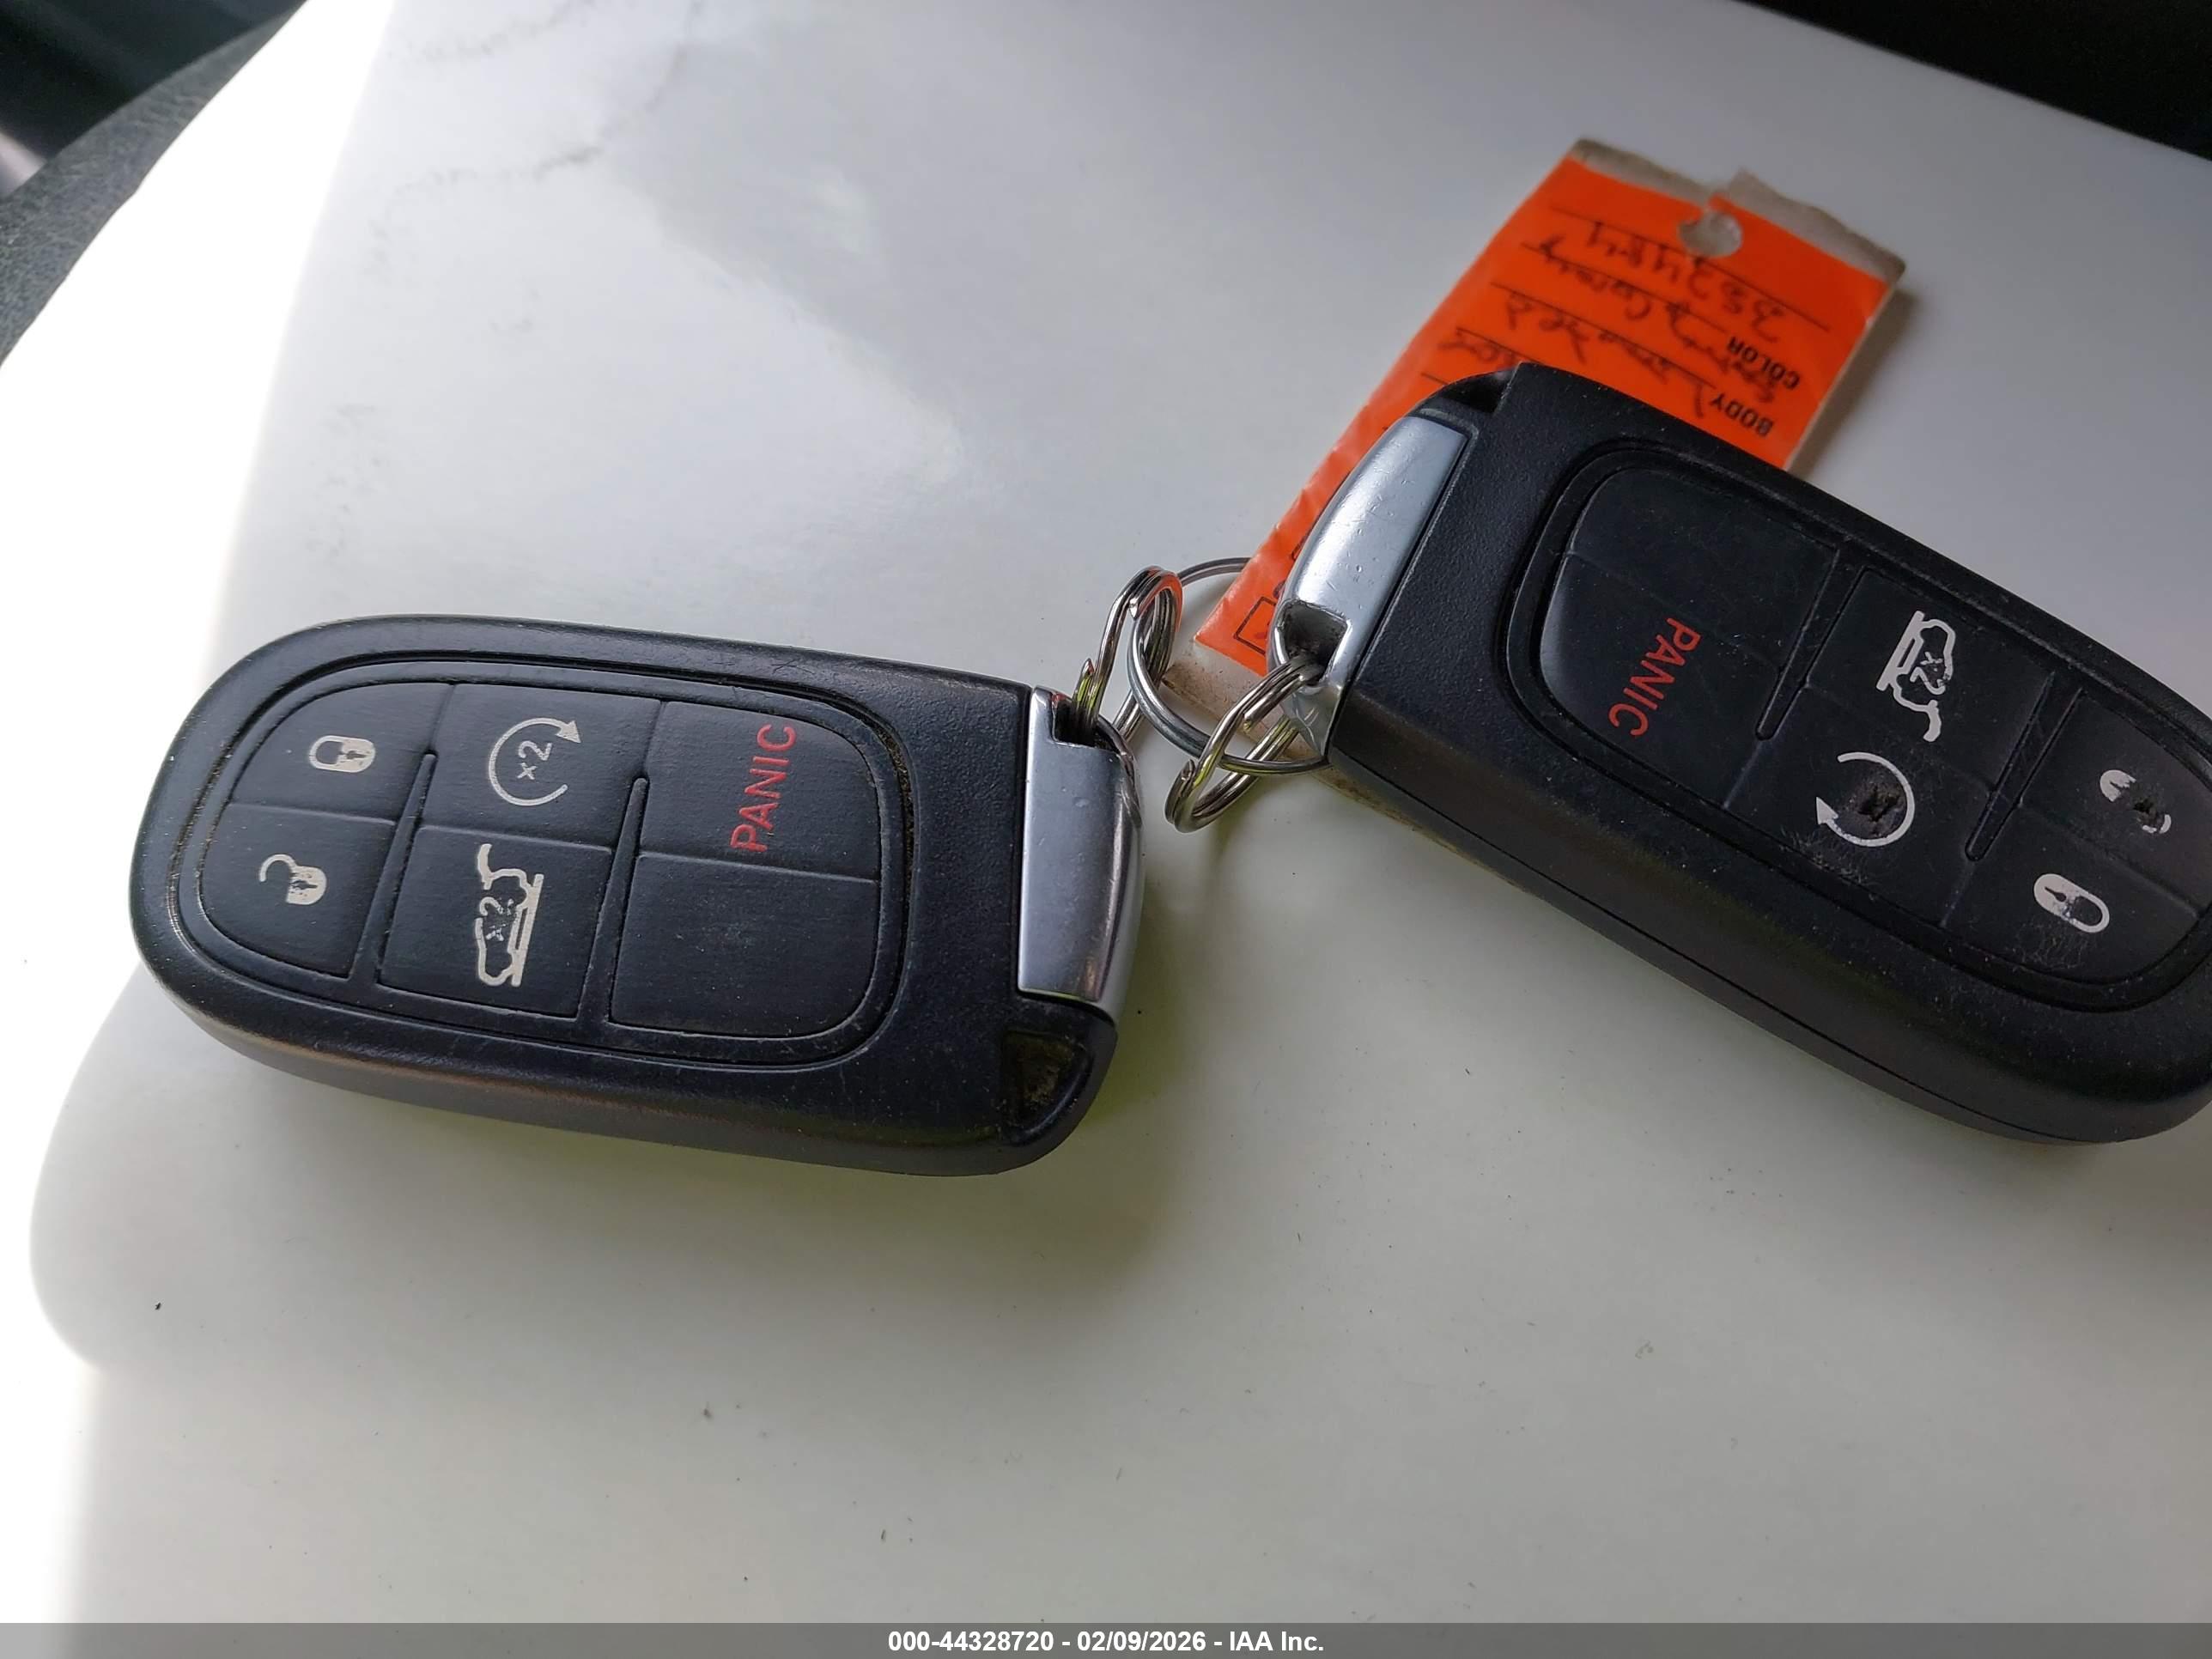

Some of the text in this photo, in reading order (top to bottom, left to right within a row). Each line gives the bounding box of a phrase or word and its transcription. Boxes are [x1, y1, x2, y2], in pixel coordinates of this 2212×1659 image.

[1729, 336, 1801, 392] COLOR
[1709, 392, 1775, 438] BODY
[1607, 617, 1701, 737] PANIC
[730, 723, 797, 853] PANIC
